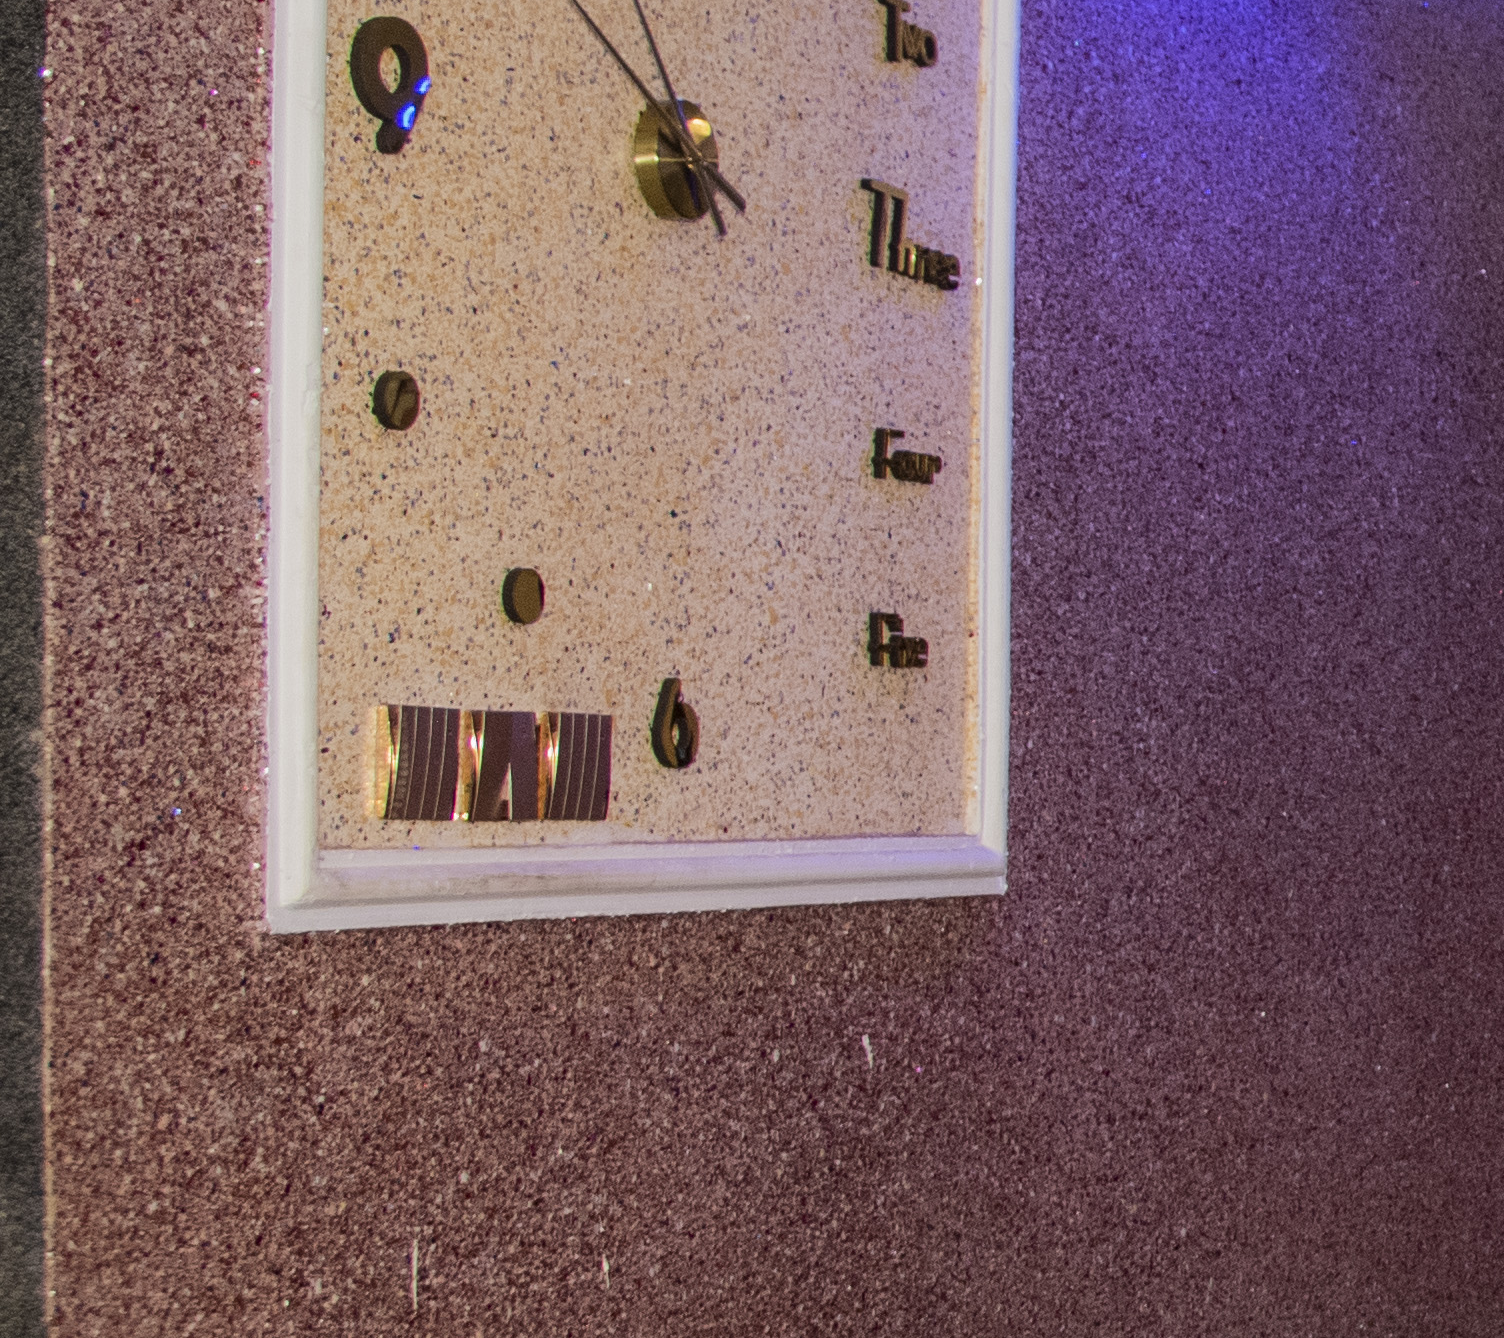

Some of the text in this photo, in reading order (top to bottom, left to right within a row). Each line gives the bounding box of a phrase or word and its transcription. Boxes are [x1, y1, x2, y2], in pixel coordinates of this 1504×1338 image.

[348, 16, 432, 156] 9
[860, 178, 962, 292] Three
[649, 676, 701, 770] 6
